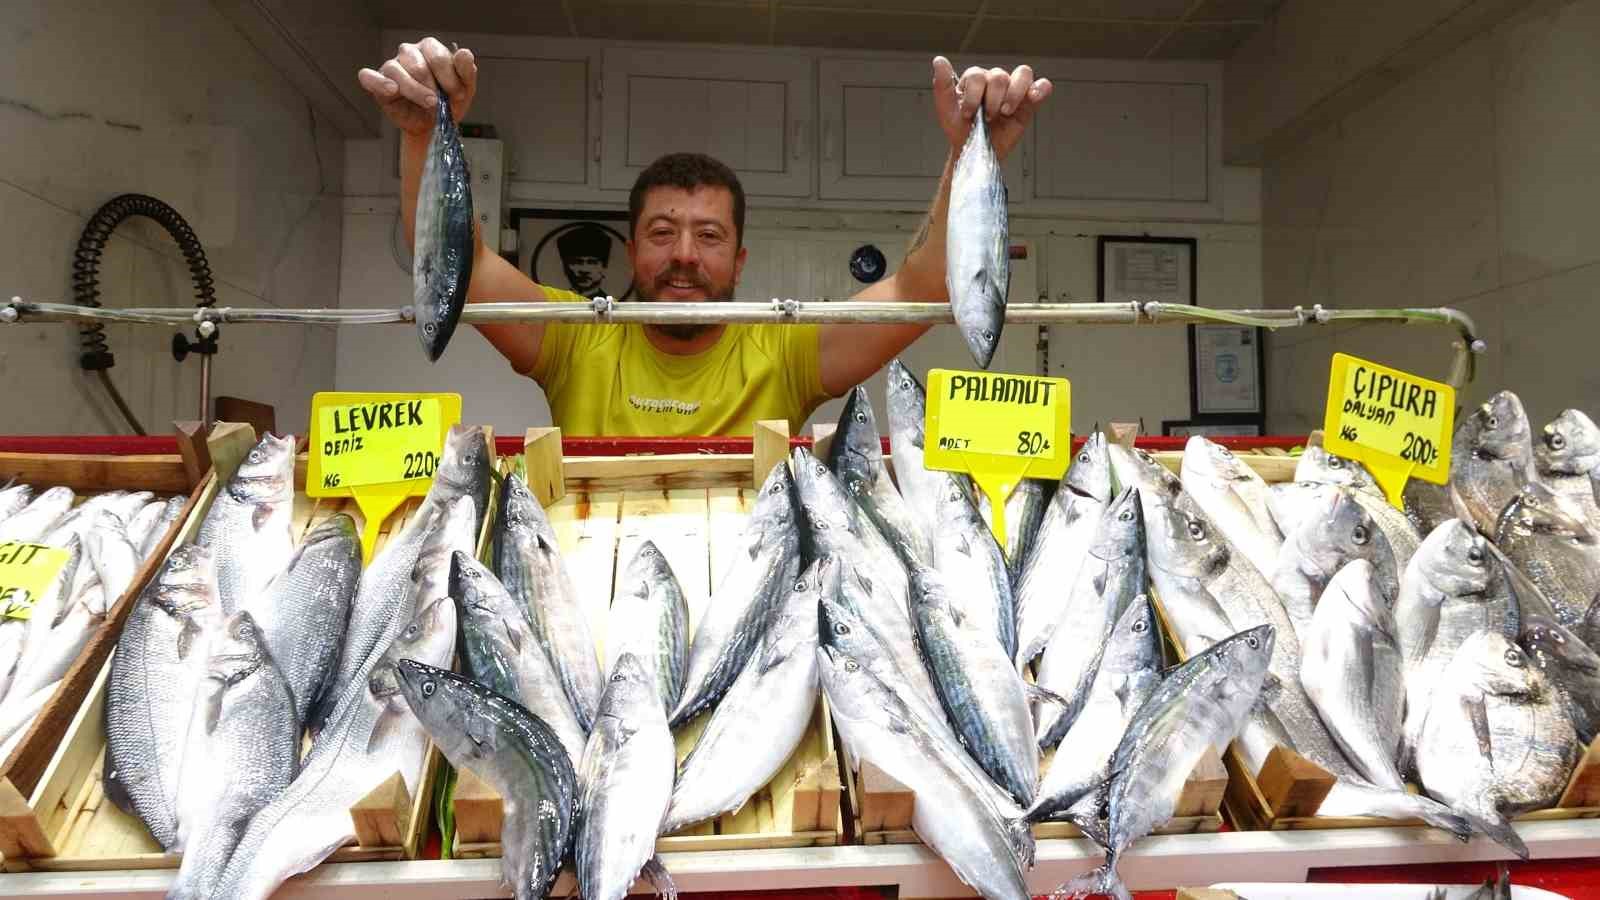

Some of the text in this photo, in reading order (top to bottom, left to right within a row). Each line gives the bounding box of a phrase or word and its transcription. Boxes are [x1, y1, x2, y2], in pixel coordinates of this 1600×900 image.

[950, 375, 1056, 406] PALAMUT
[334, 400, 423, 434] LEVREK
[1343, 399, 1396, 426] DALYAN
[1339, 425, 1358, 442] KG
[323, 474, 341, 488] KG
